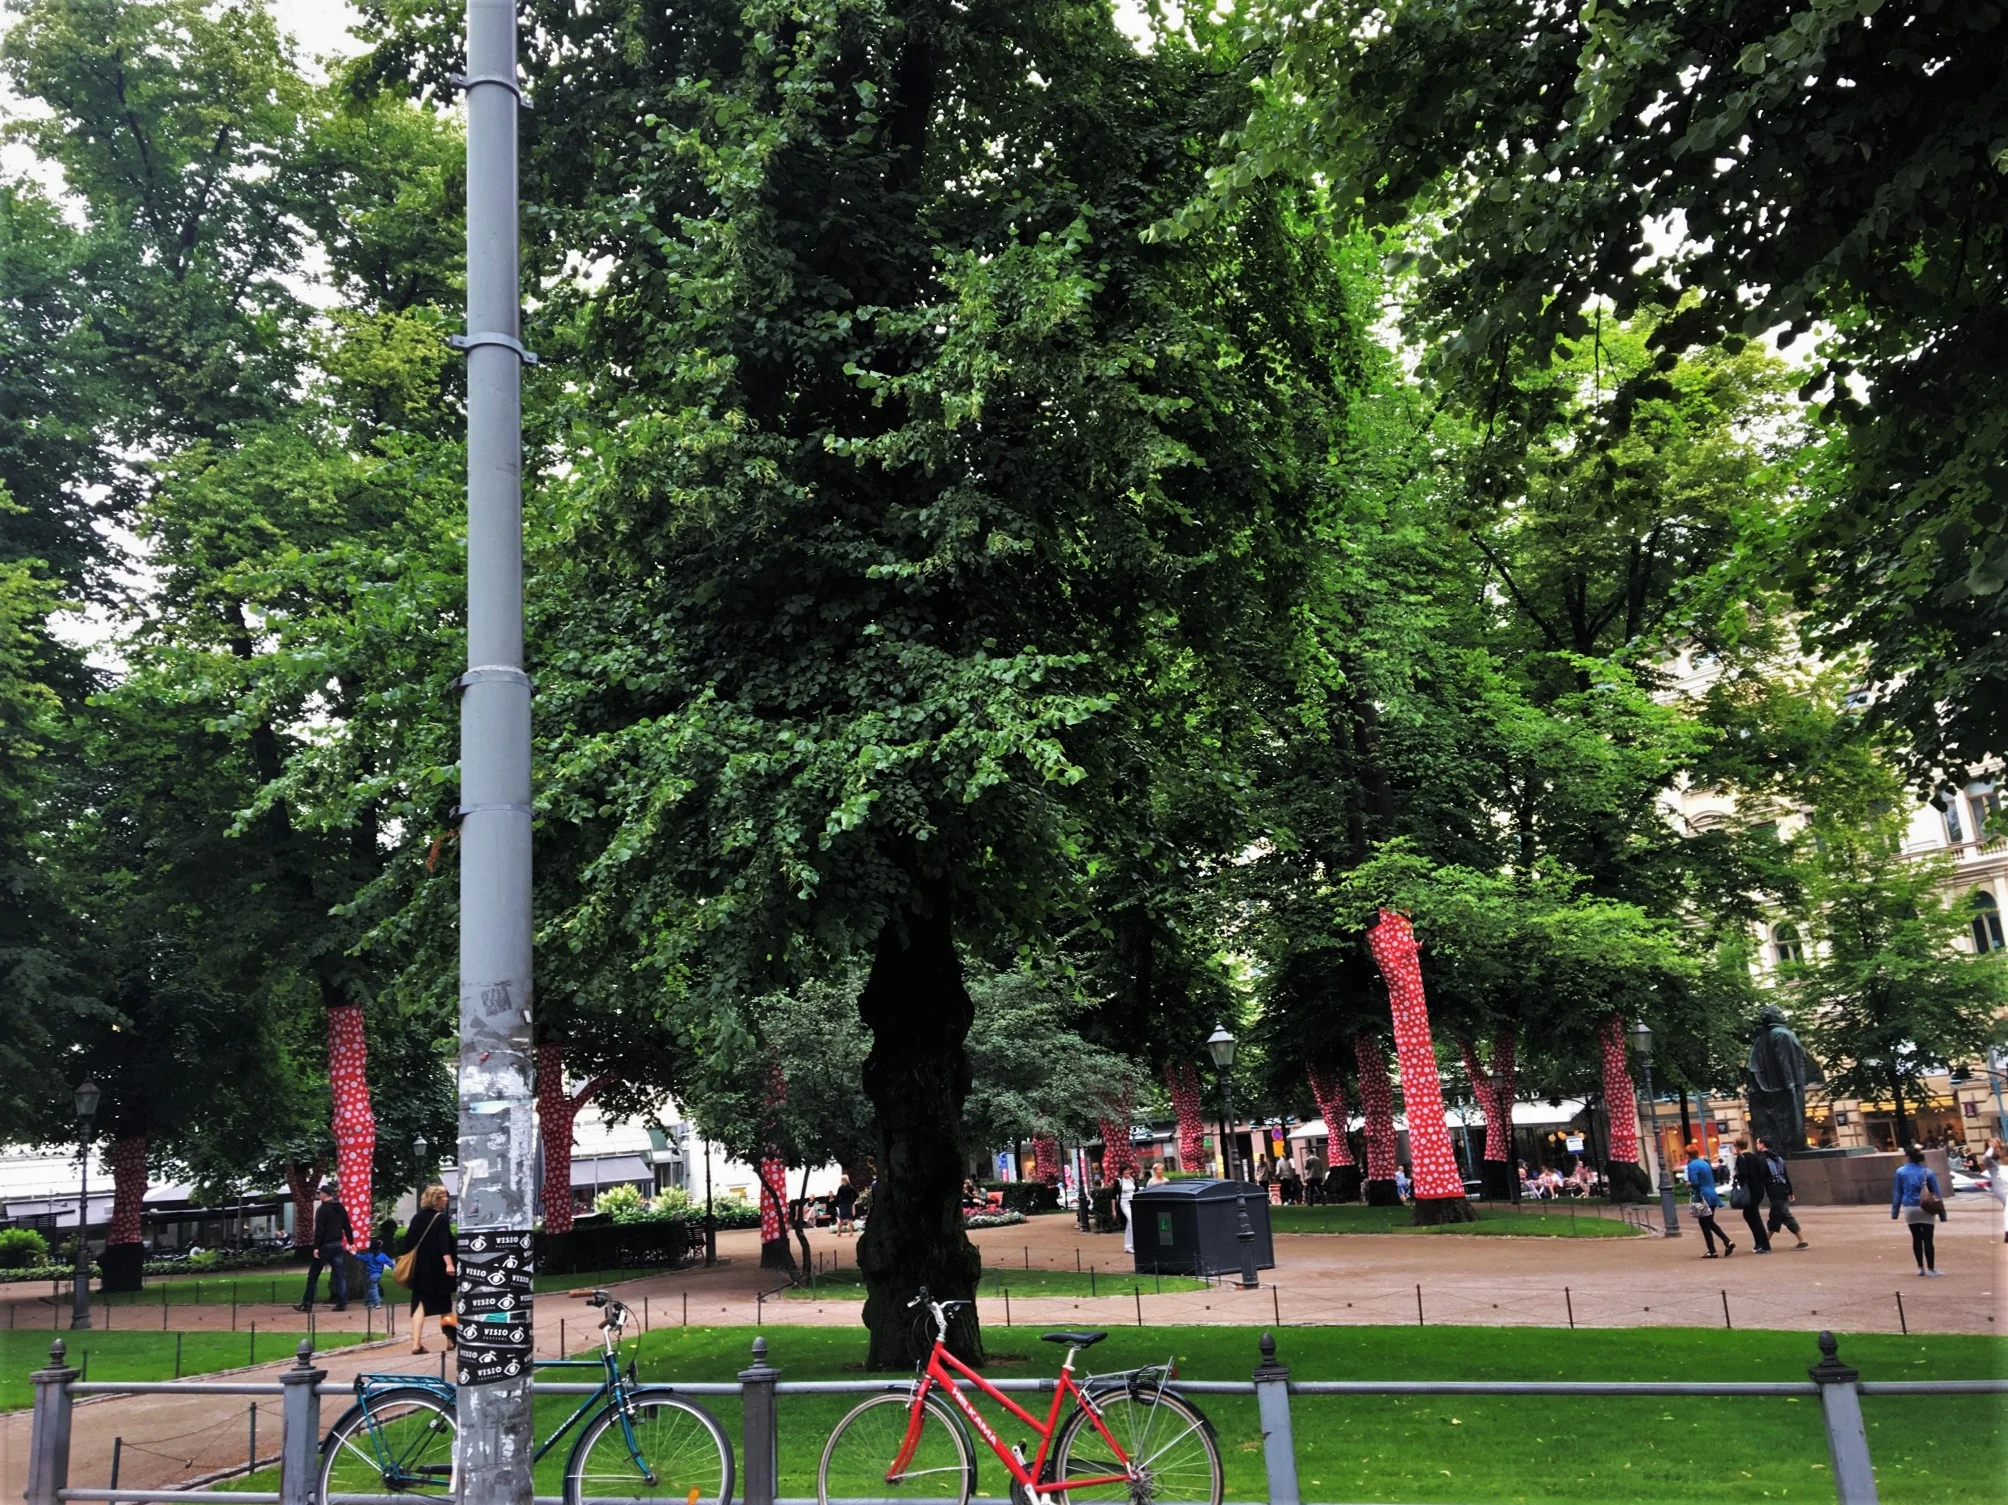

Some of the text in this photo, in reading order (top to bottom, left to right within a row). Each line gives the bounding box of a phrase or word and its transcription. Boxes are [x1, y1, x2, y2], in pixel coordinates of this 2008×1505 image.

[466, 1267, 487, 1277] VISIO
[512, 1274, 530, 1283] VISIO
[472, 1298, 496, 1306] VISIO
[484, 1328, 509, 1336] VISIO
[460, 1350, 478, 1358] VISIO
[477, 1366, 503, 1376] VISIO
[952, 1386, 997, 1447] HELKAMA
